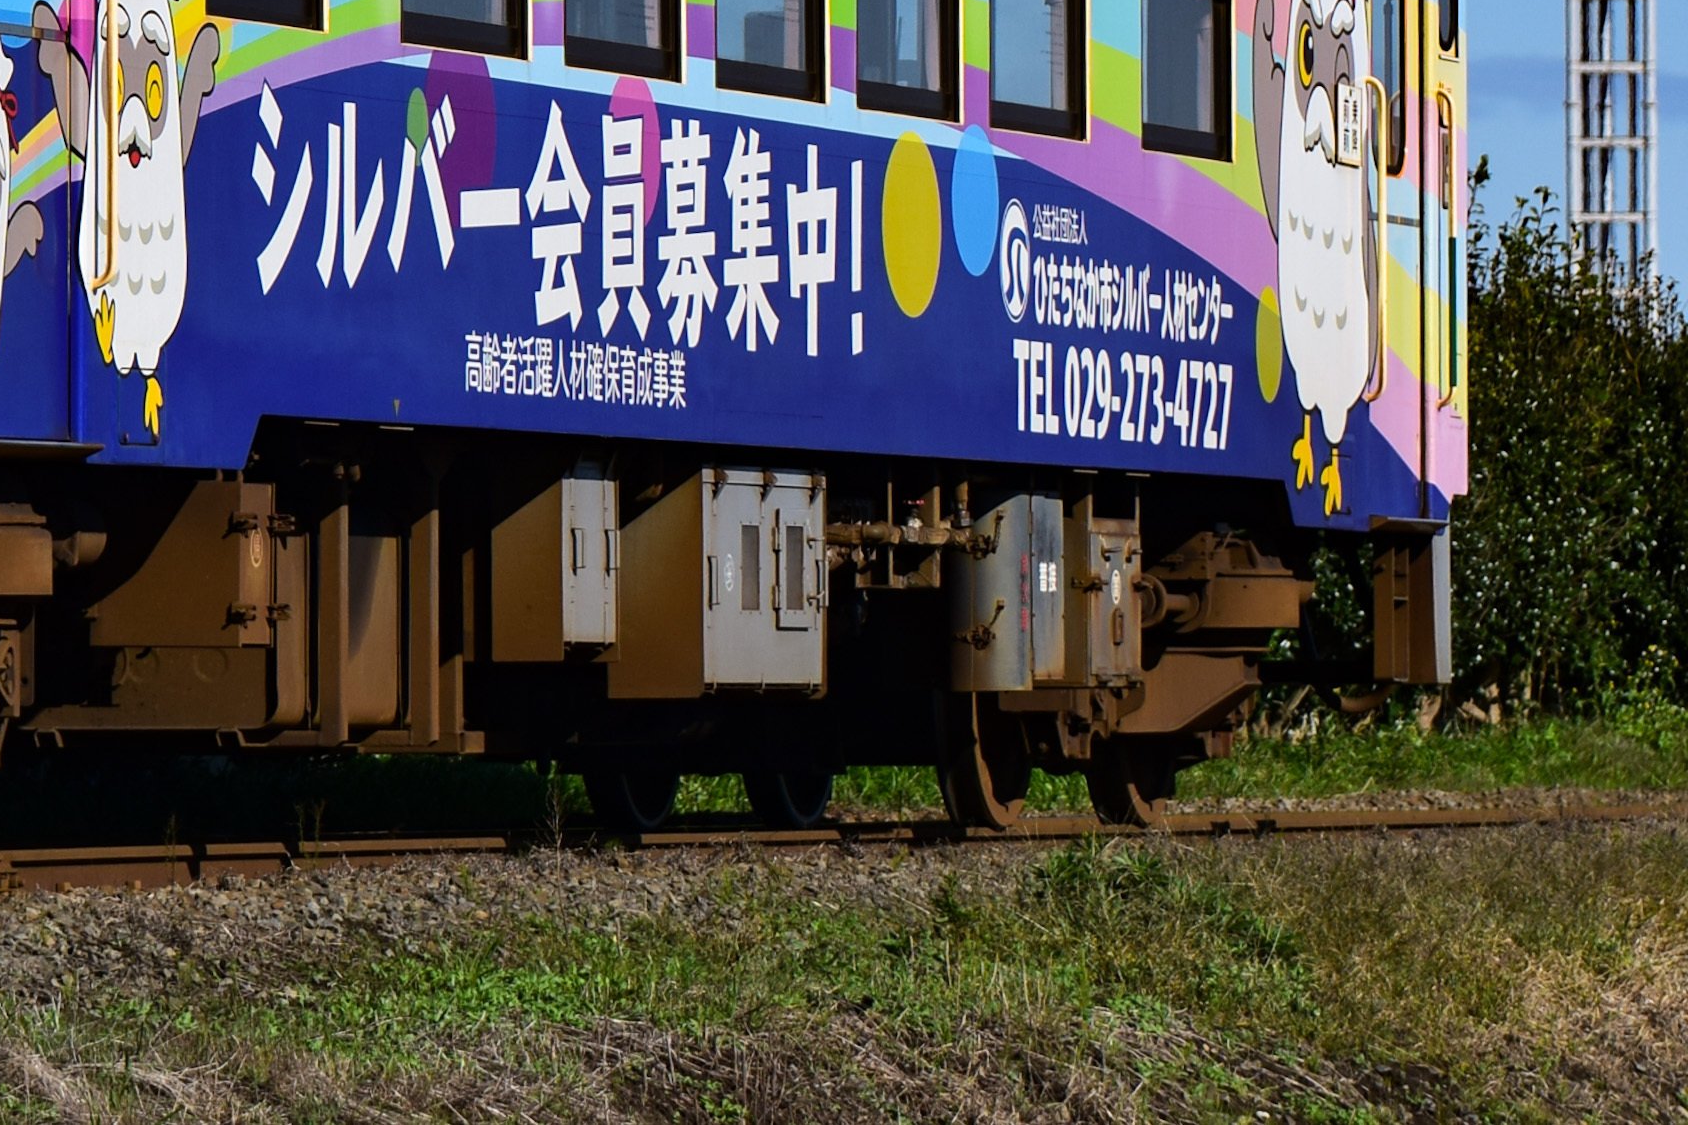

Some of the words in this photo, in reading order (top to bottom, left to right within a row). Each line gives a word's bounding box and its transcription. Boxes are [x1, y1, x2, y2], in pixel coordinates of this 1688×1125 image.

[251, 77, 862, 357] シルバー会員募集中!
[1032, 203, 1088, 246] 公益社団法人
[1033, 252, 1234, 346] ひたちなか市シルバー人材センター
[464, 330, 687, 410] 高齢者活躍人材確保育成事業
[1013, 338, 1059, 435] TEL
[1064, 345, 1233, 451] 029-273-4727
